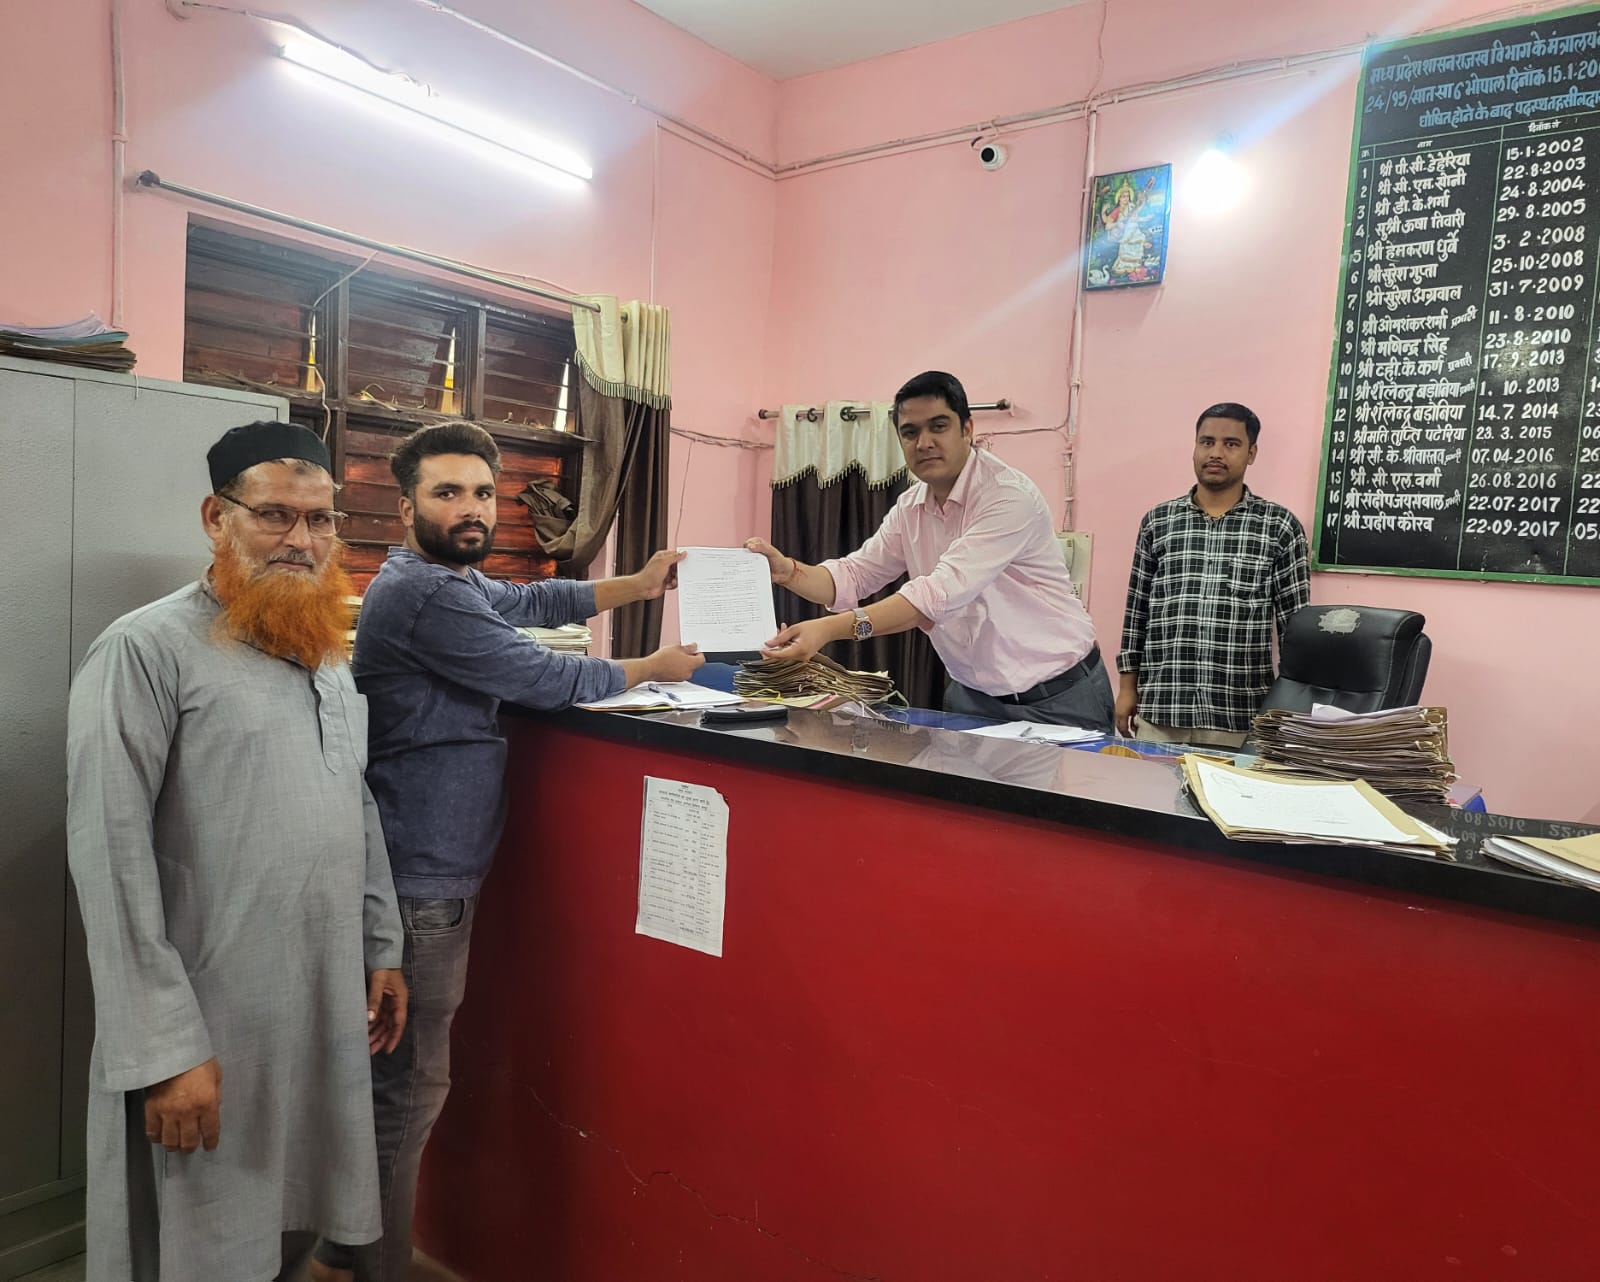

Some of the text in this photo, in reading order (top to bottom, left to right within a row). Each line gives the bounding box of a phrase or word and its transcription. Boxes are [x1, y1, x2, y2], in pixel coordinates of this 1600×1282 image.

[1421, 55, 1454, 76] शासन
[1490, 40, 1532, 64] विभाग
[1530, 31, 1546, 56] के
[1465, 72, 1505, 96] भोपाल
[1451, 104, 1474, 128] होने
[1475, 101, 1489, 120] के
[1490, 103, 1514, 119] बाद
[1362, 168, 1368, 179] 1
[1380, 160, 1392, 177] श्री
[1506, 137, 1584, 160] 15.1.2002
[1360, 186, 1367, 198] 2
[1378, 178, 1392, 195] श्री
[1503, 157, 1586, 180] 22.8.2003
[1357, 205, 1365, 219] 3
[1375, 197, 1391, 216] श्री
[1500, 176, 1585, 201] 24.8.2004
[1355, 224, 1365, 238] 4
[1431, 208, 1465, 229] तिवारी
[1352, 250, 1361, 263] 5
[1367, 240, 1384, 262] श्री
[1350, 249, 1584, 287] 6 श्री सुरेश गुप्ता 25.10.2008
[1347, 274, 1584, 311] 7 श्री सुरेश अग्रवाल 31.7.2009
[1346, 320, 1354, 333] 8
[1362, 313, 1378, 336] श्री
[1425, 307, 1448, 329] शर्मा
[1345, 342, 1353, 354] 9
[1360, 336, 1376, 356] श्री
[1423, 331, 1450, 355] सिंह
[1484, 327, 1572, 349] 23.8.2010
[1340, 363, 1352, 375] 10
[1357, 357, 1375, 378] श्री
[1338, 386, 1348, 400] 11
[1355, 380, 1371, 401] श्री
[1333, 408, 1346, 422] 12
[1355, 401, 1371, 423] श्री
[1333, 431, 1345, 443] 13
[1332, 449, 1344, 464] 14
[1349, 445, 1366, 464] श्री
[1331, 471, 1341, 484] 15
[1469, 472, 1557, 490] 26.08.2016
[1329, 490, 1340, 504] 16
[1344, 487, 1362, 509] श्री
[1468, 495, 1561, 512] 22.07.2017
[1326, 513, 1338, 528] 17
[1343, 510, 1361, 530] श्री
[1360, 511, 1397, 533] प्रदीप
[1465, 518, 1560, 537] 22.09.2017
